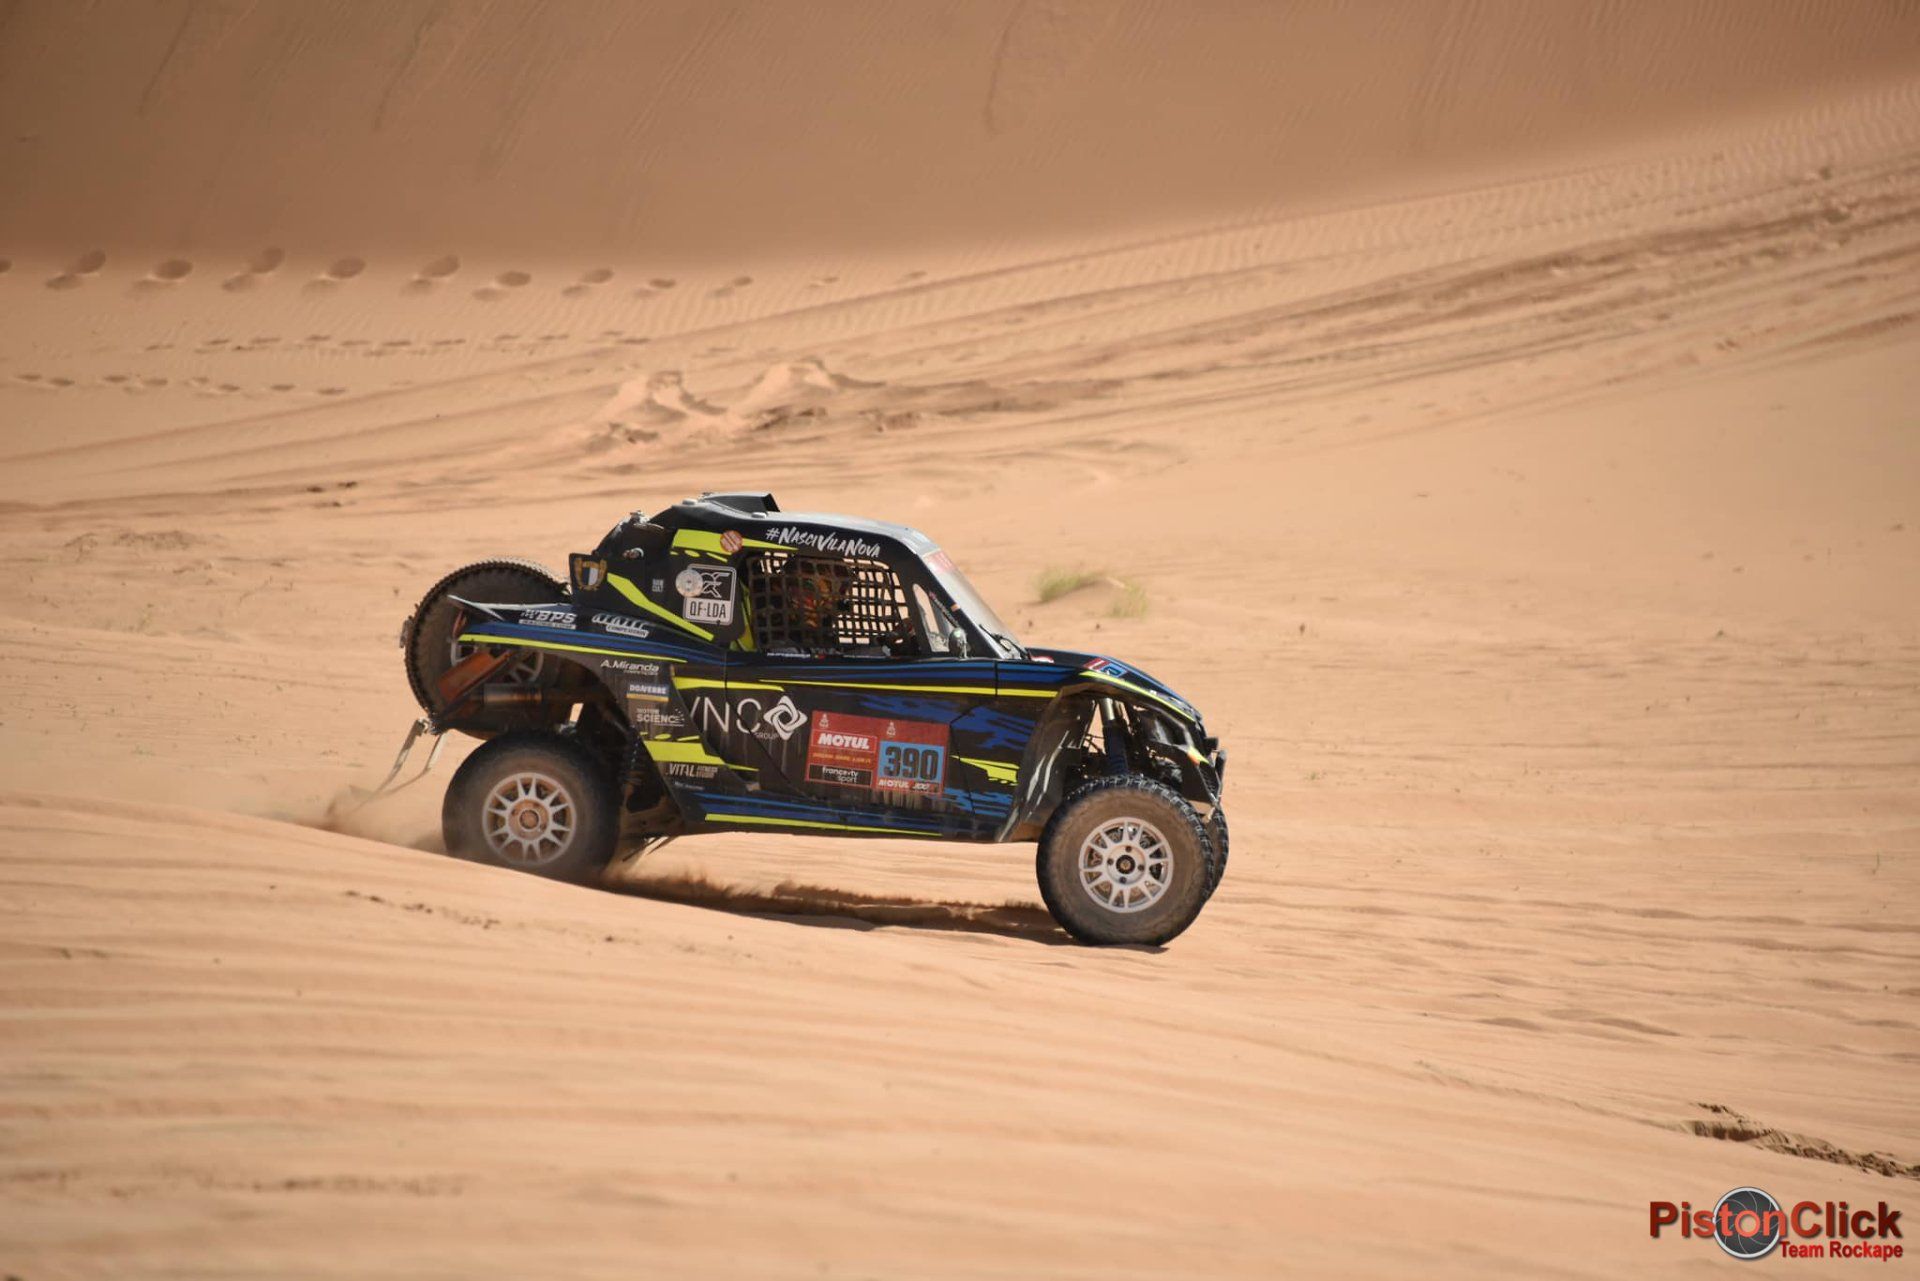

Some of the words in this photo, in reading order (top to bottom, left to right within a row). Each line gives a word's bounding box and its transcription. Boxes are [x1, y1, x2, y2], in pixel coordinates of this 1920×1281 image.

[818, 733, 870, 750] MOTUL
[883, 746, 939, 780] 390
[878, 779, 909, 789] MOTUL
